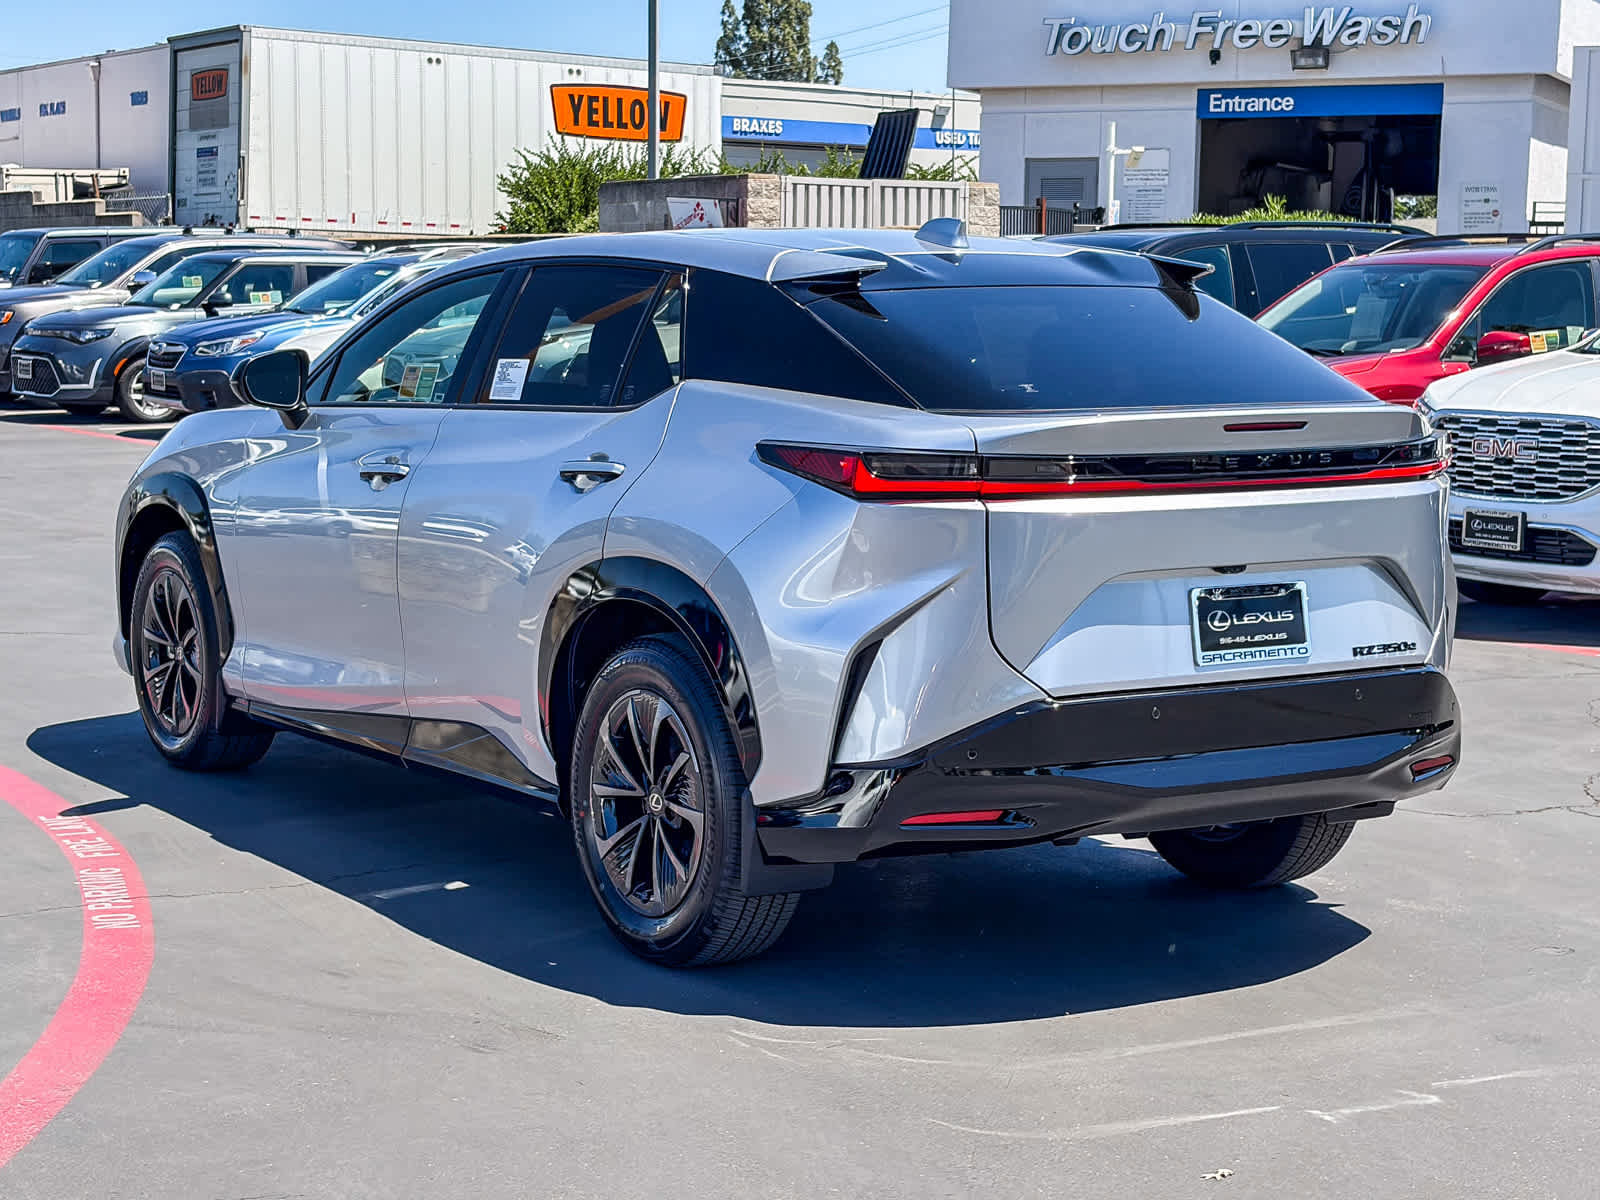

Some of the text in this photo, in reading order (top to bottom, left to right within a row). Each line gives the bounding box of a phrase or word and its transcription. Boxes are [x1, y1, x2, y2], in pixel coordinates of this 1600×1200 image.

[1043, 3, 1432, 56] Touch Free Wash
[195, 74, 224, 96] YELLOW
[1209, 93, 1295, 113] Entrance
[733, 118, 783, 134] BRAKES
[935, 131, 980, 146] USED TI
[1472, 439, 1538, 461] GMC
[1483, 522, 1515, 532] LEXUS
[1232, 611, 1294, 625] LEXUS
[1202, 647, 1309, 664] SACRAMENTO
[38, 816, 142, 929] NO PARKING FIRE LANE
